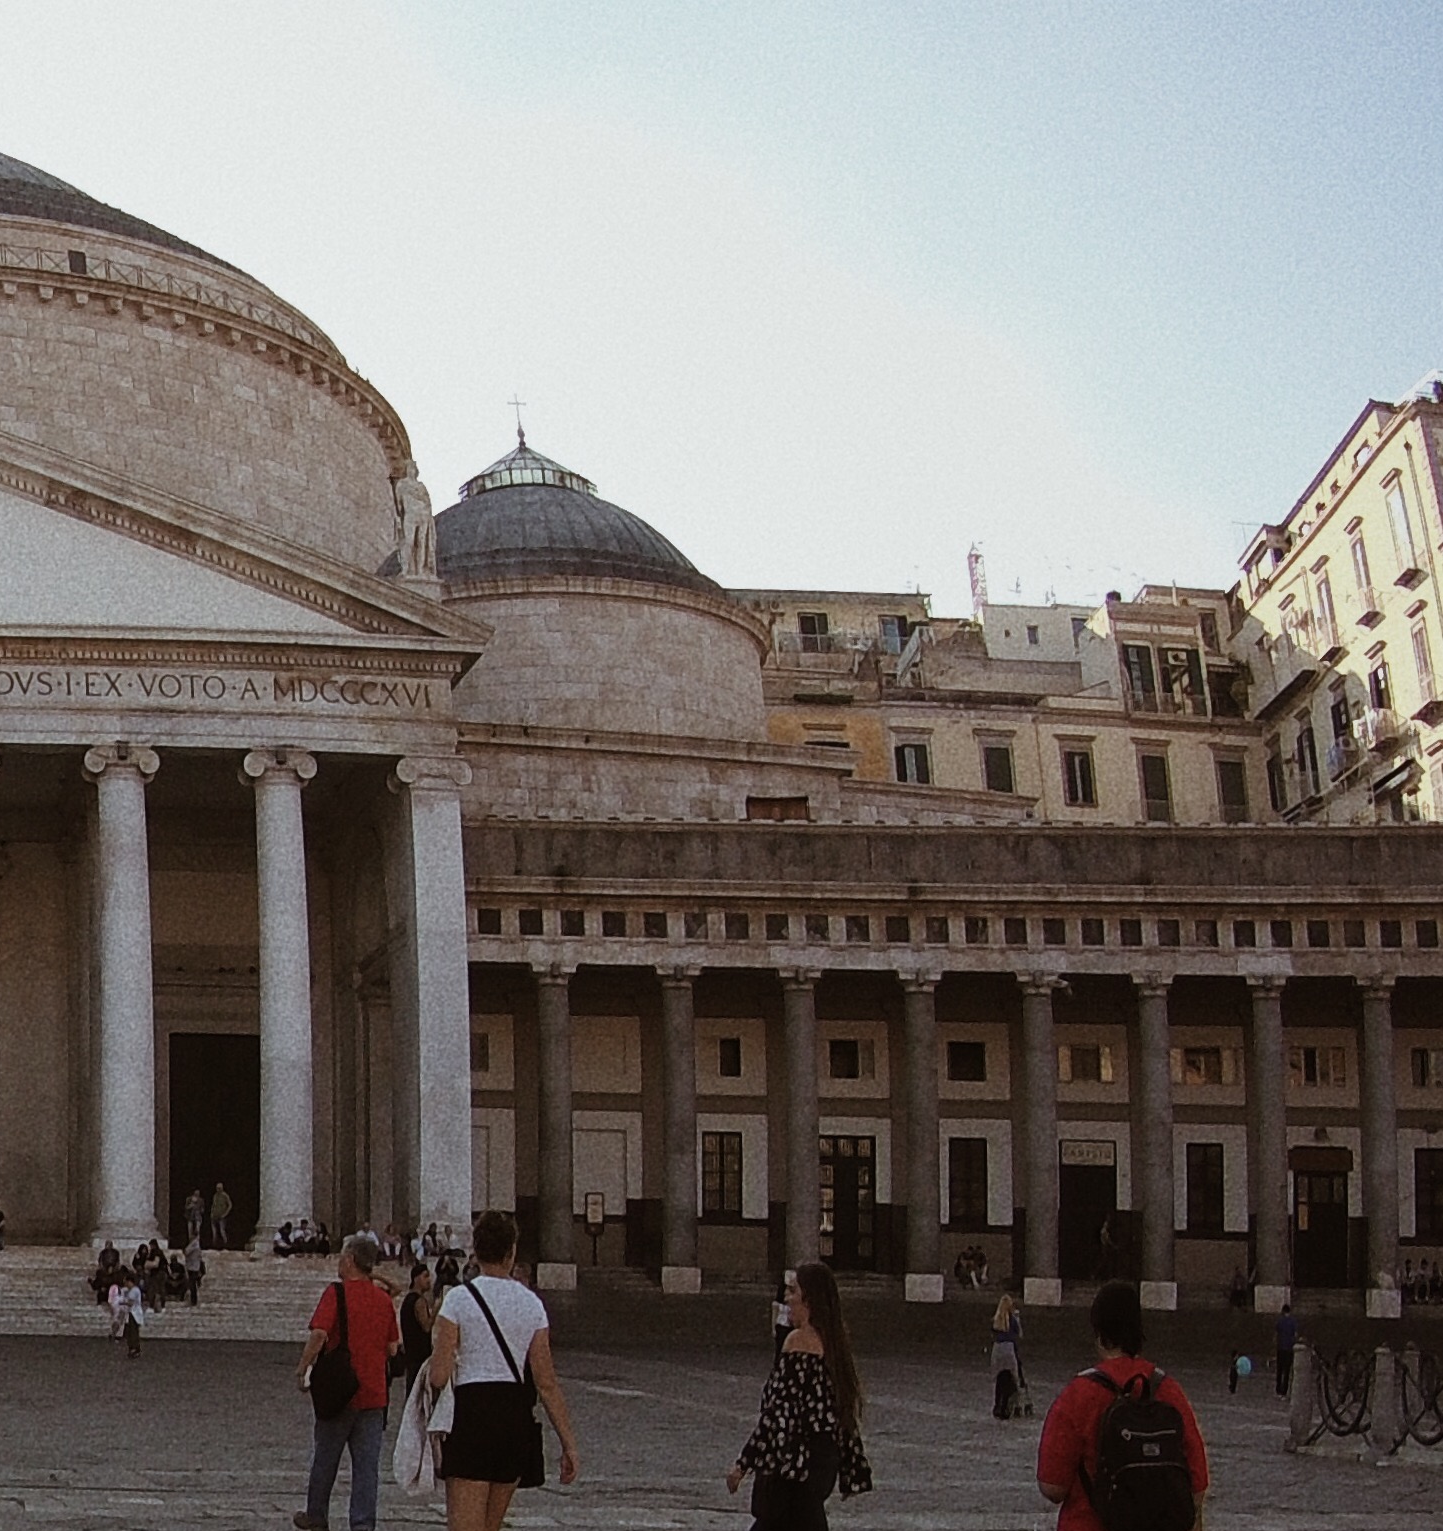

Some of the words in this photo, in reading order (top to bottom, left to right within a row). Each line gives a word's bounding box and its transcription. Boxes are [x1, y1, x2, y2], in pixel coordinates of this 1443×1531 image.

[84, 672, 123, 698] EX
[137, 673, 226, 701] VOTO
[239, 676, 261, 701] A
[273, 675, 433, 709] MDCCCXVI
